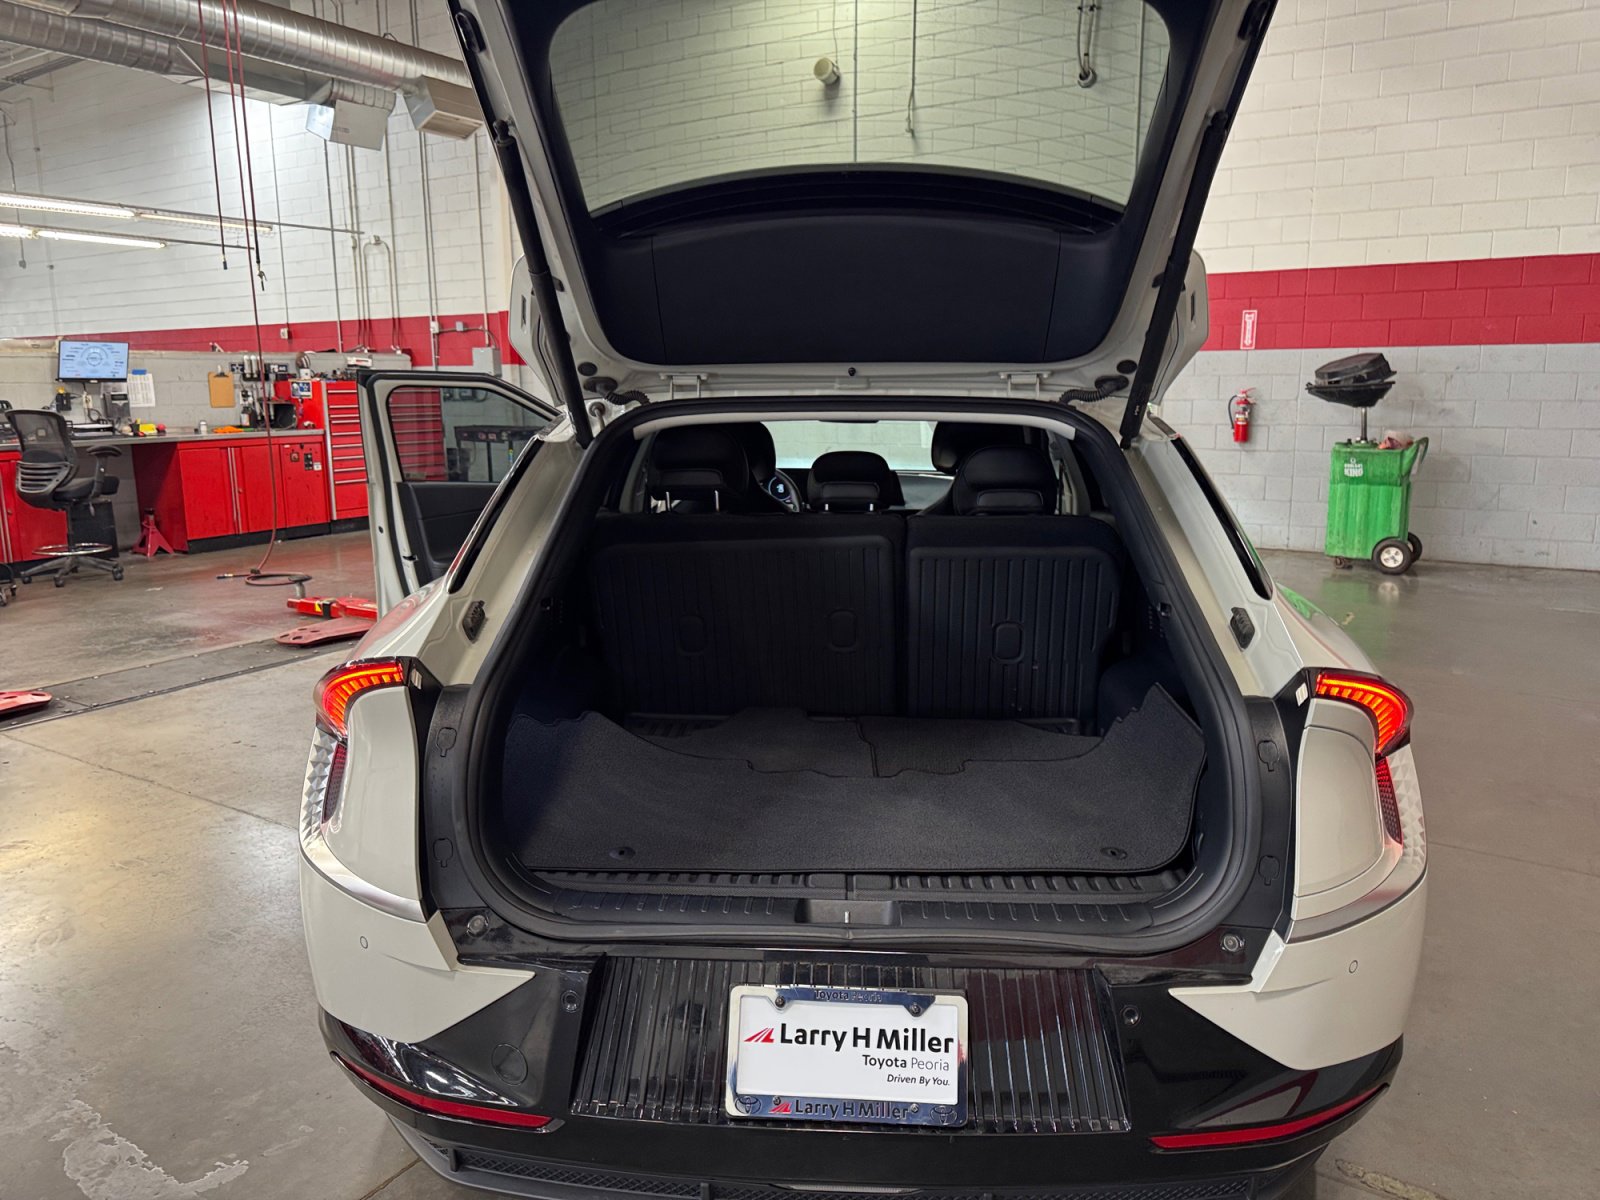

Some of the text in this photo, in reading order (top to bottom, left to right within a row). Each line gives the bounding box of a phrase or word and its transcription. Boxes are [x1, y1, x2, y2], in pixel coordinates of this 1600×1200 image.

[814, 990, 849, 1001] Toyota
[780, 1023, 954, 1054] Larry H Miller
[862, 1054, 949, 1071] Toyota Peoria
[887, 1074, 950, 1087] Driven By You.
[795, 1100, 909, 1119] Larry H Miller
